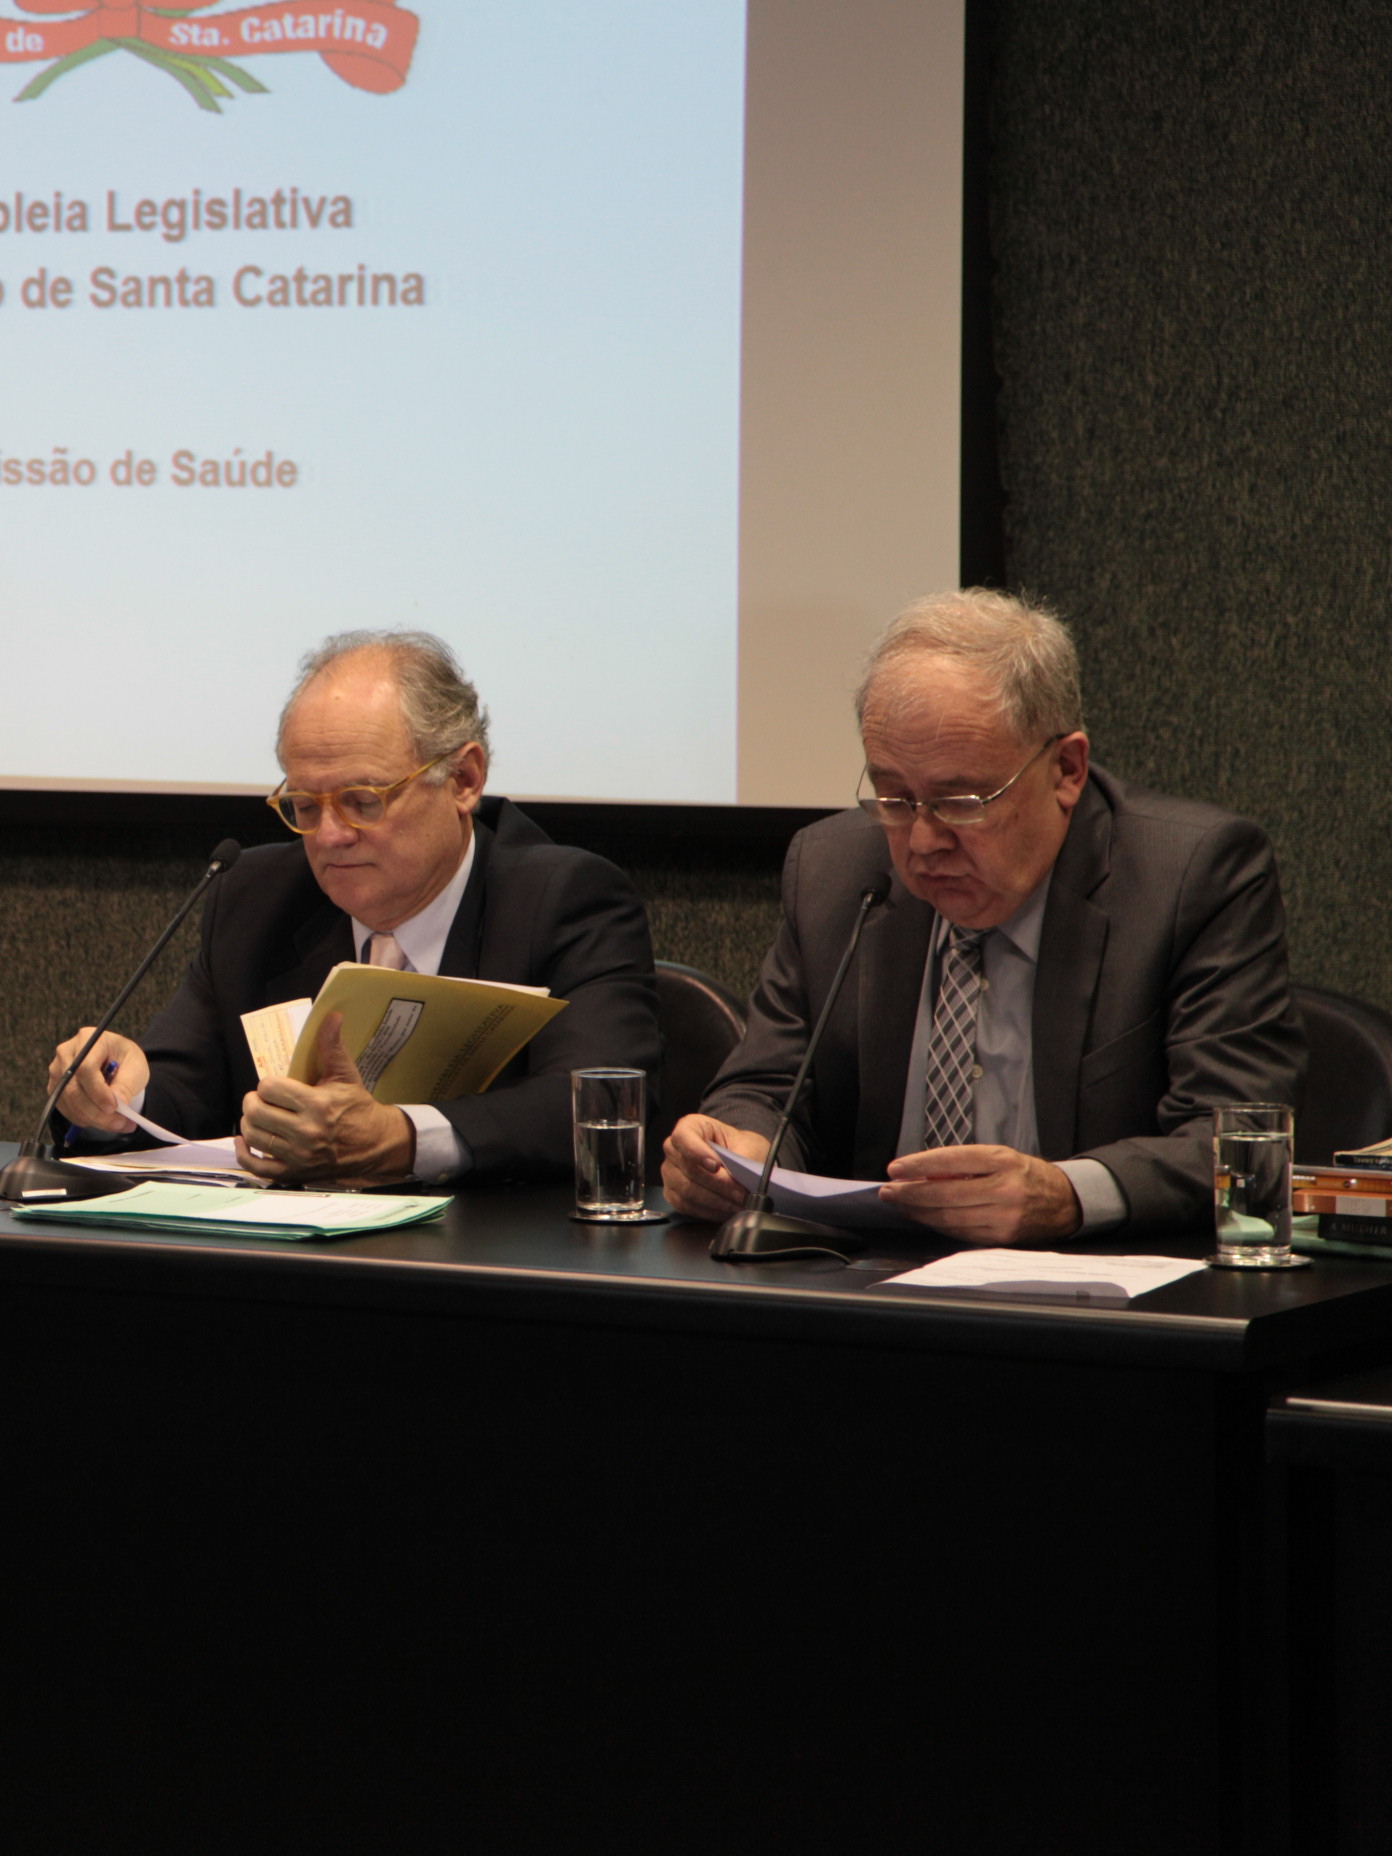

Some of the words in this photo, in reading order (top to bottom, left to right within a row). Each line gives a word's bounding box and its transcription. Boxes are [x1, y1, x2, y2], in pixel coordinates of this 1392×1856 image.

[5, 27, 44, 53] de
[169, 22, 230, 46] Sta.
[240, 8, 388, 50] Catarina
[107, 187, 353, 242] Legislativa
[20, 266, 73, 309] de
[89, 266, 216, 309] Santa
[233, 263, 425, 307] Catarina
[110, 449, 157, 487] de
[170, 447, 298, 488] Saúde
